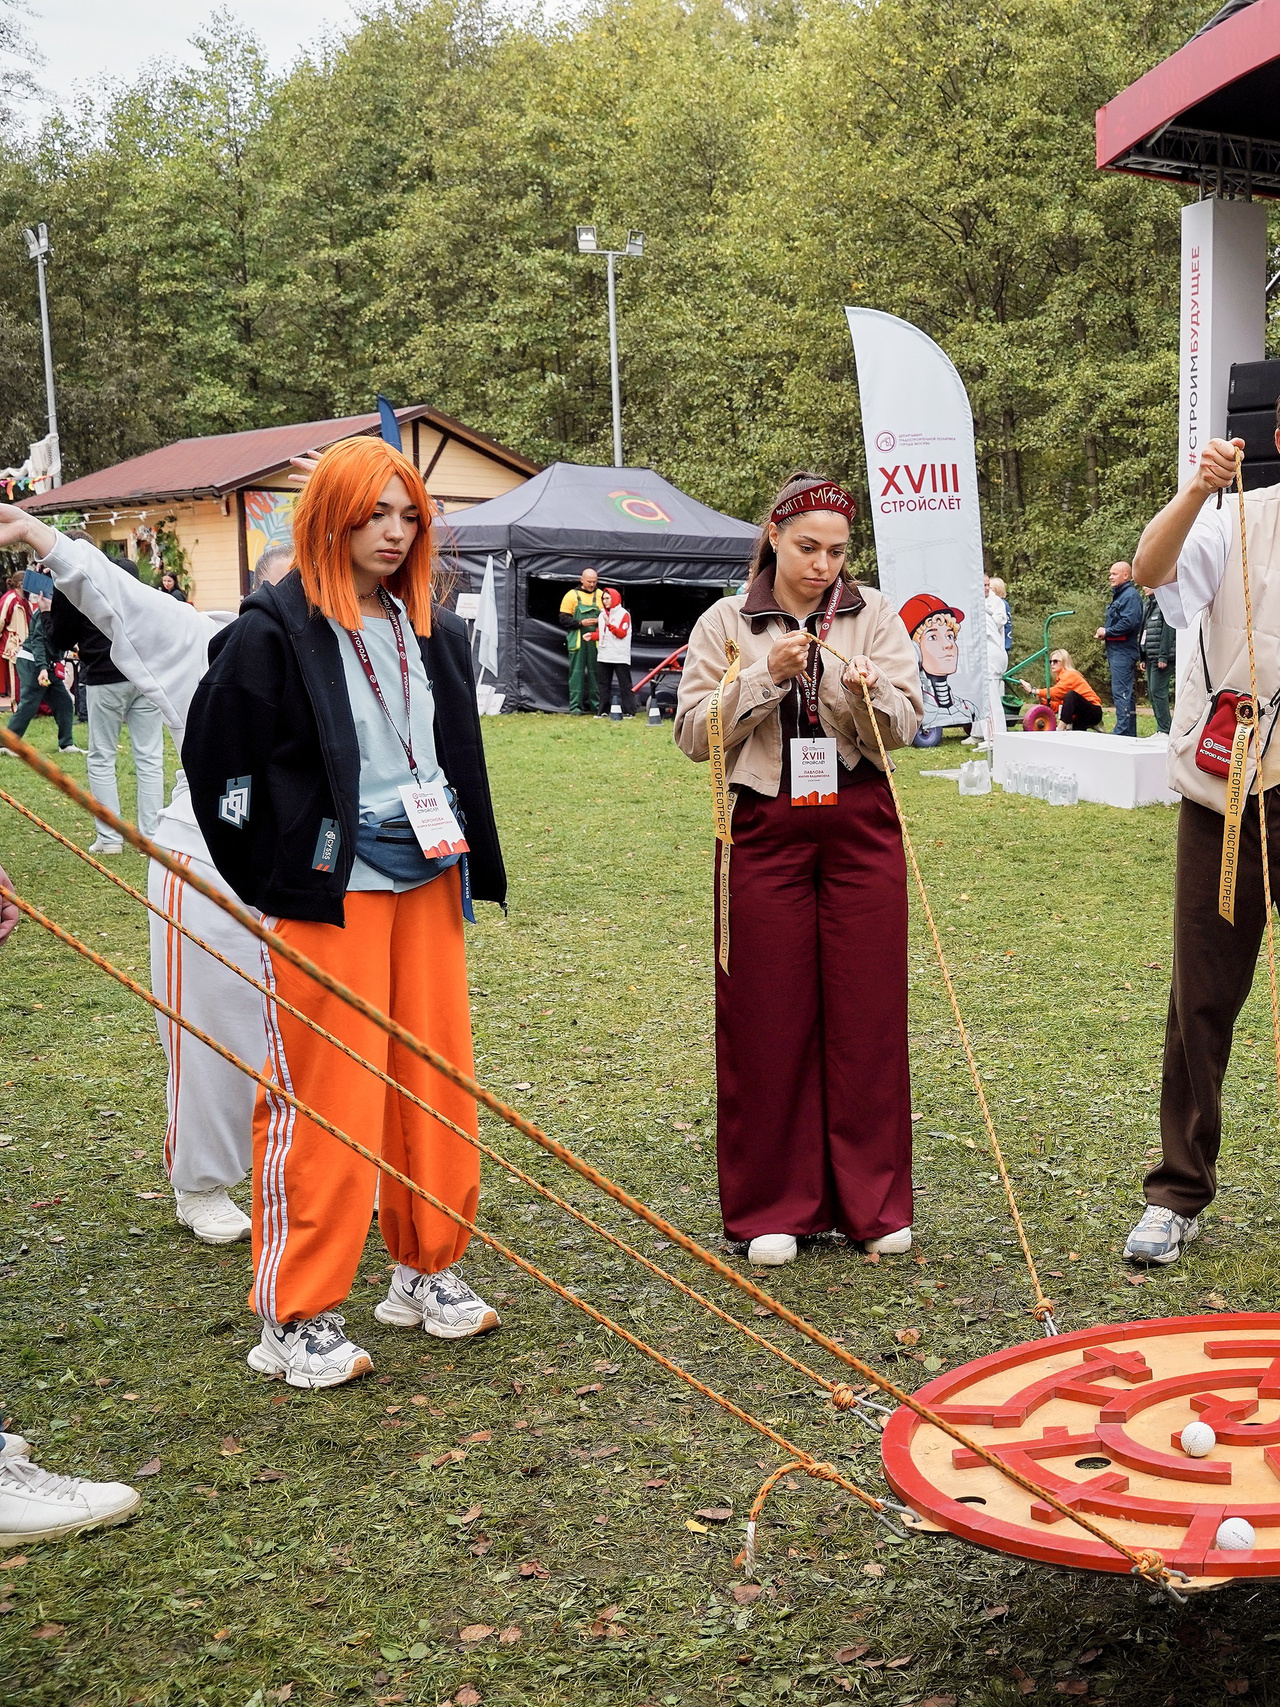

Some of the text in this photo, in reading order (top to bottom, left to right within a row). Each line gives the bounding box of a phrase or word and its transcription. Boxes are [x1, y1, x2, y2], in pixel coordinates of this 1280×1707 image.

[1188, 245, 1201, 467] #СТРОИМБУДУЩЕЕ
[878, 463, 960, 497] XVIII
[880, 495, 962, 514] СТРОЙСЛЁТ
[353, 636, 368, 664] ГОРОДА
[802, 751, 825, 760] XVIII
[1229, 726, 1248, 817] МОСГОРГЕОТРЕСТ
[414, 798, 438, 809] XVIII
[712, 745, 727, 836] МОСГОРГЕОТРЕСТ
[1222, 824, 1237, 915] МОСГОРГЕОТРЕСТ
[720, 872, 729, 960] МОСГОРГЕОТРЕСТ
